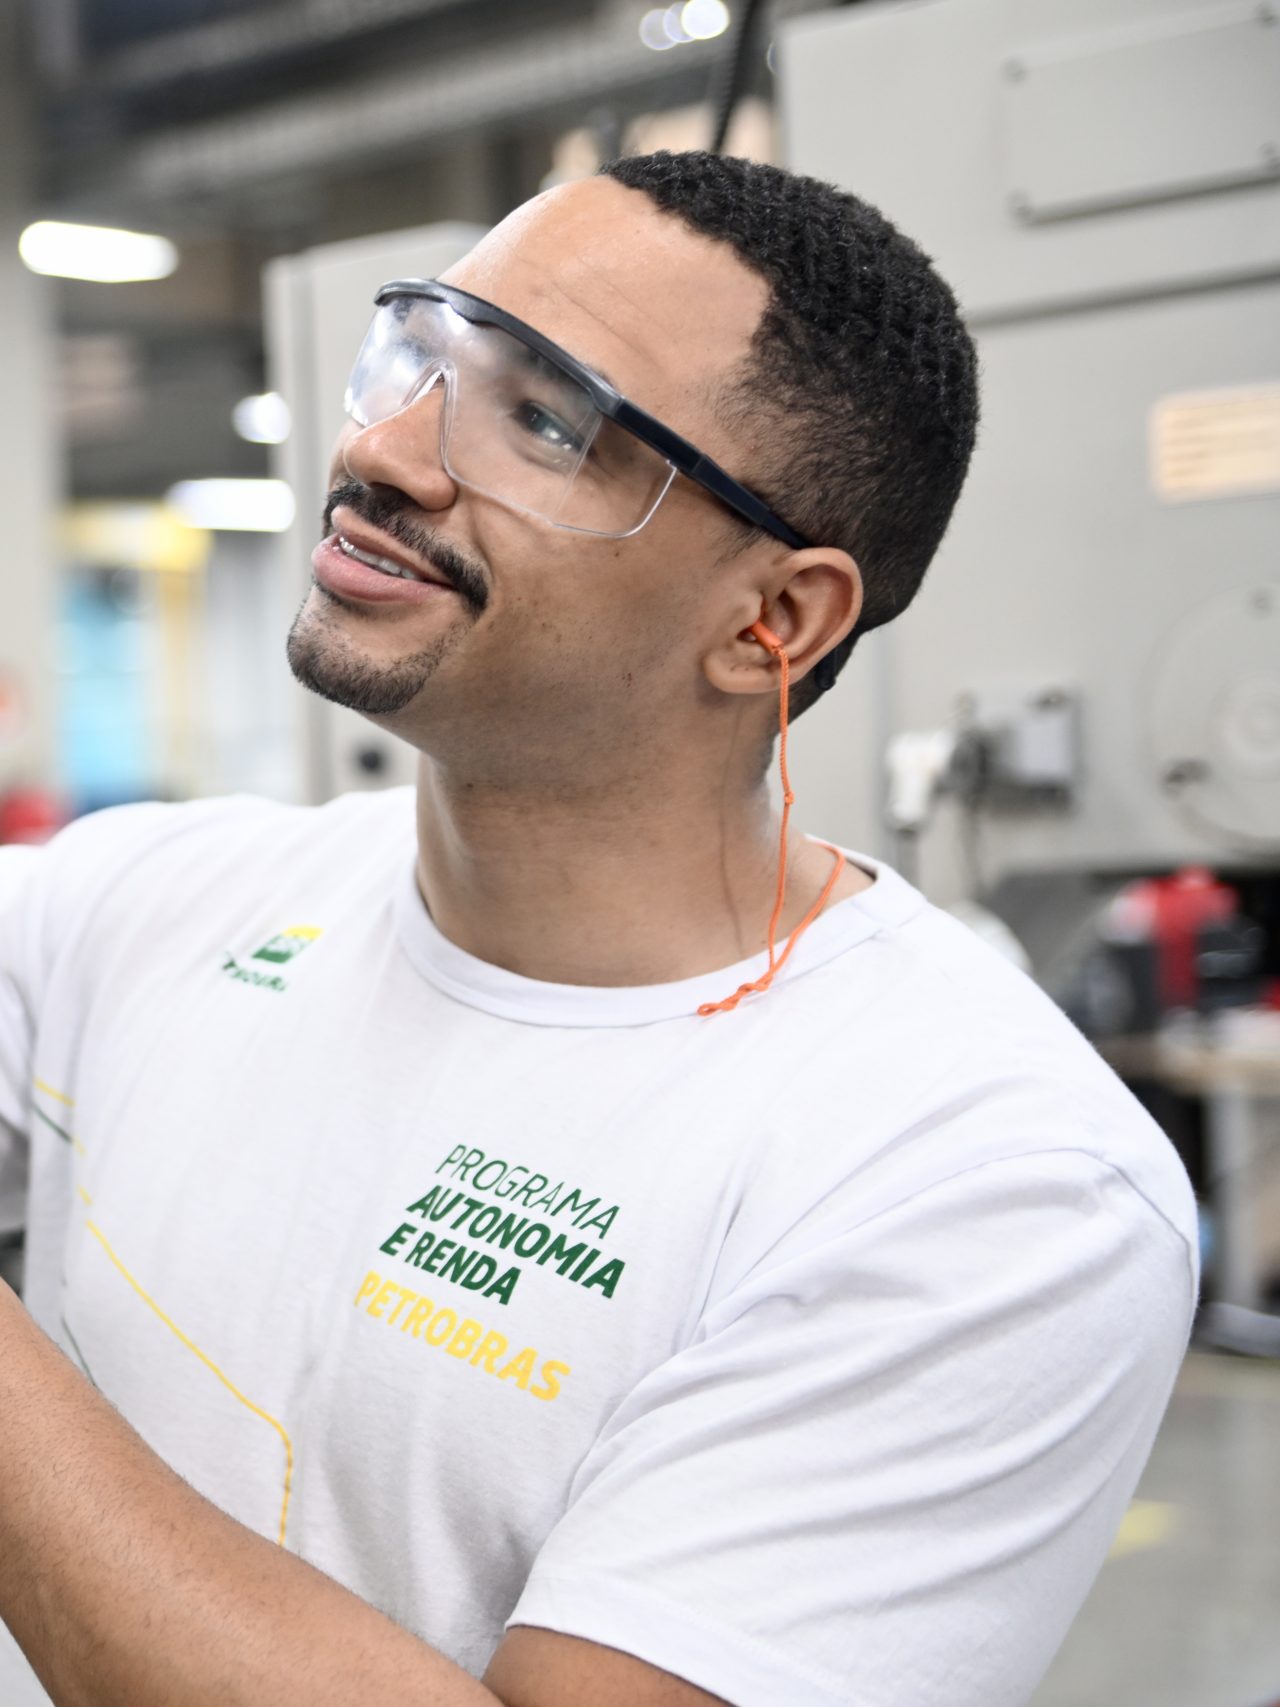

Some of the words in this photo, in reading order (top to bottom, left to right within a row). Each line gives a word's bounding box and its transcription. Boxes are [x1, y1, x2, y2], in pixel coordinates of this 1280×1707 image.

[405, 1184, 627, 1300] AUTONOMIA
[434, 1143, 621, 1240] PROGRAMA
[378, 1222, 413, 1258] E
[403, 1230, 523, 1307] RENDA
[353, 1269, 572, 1402] PETROBRAS
